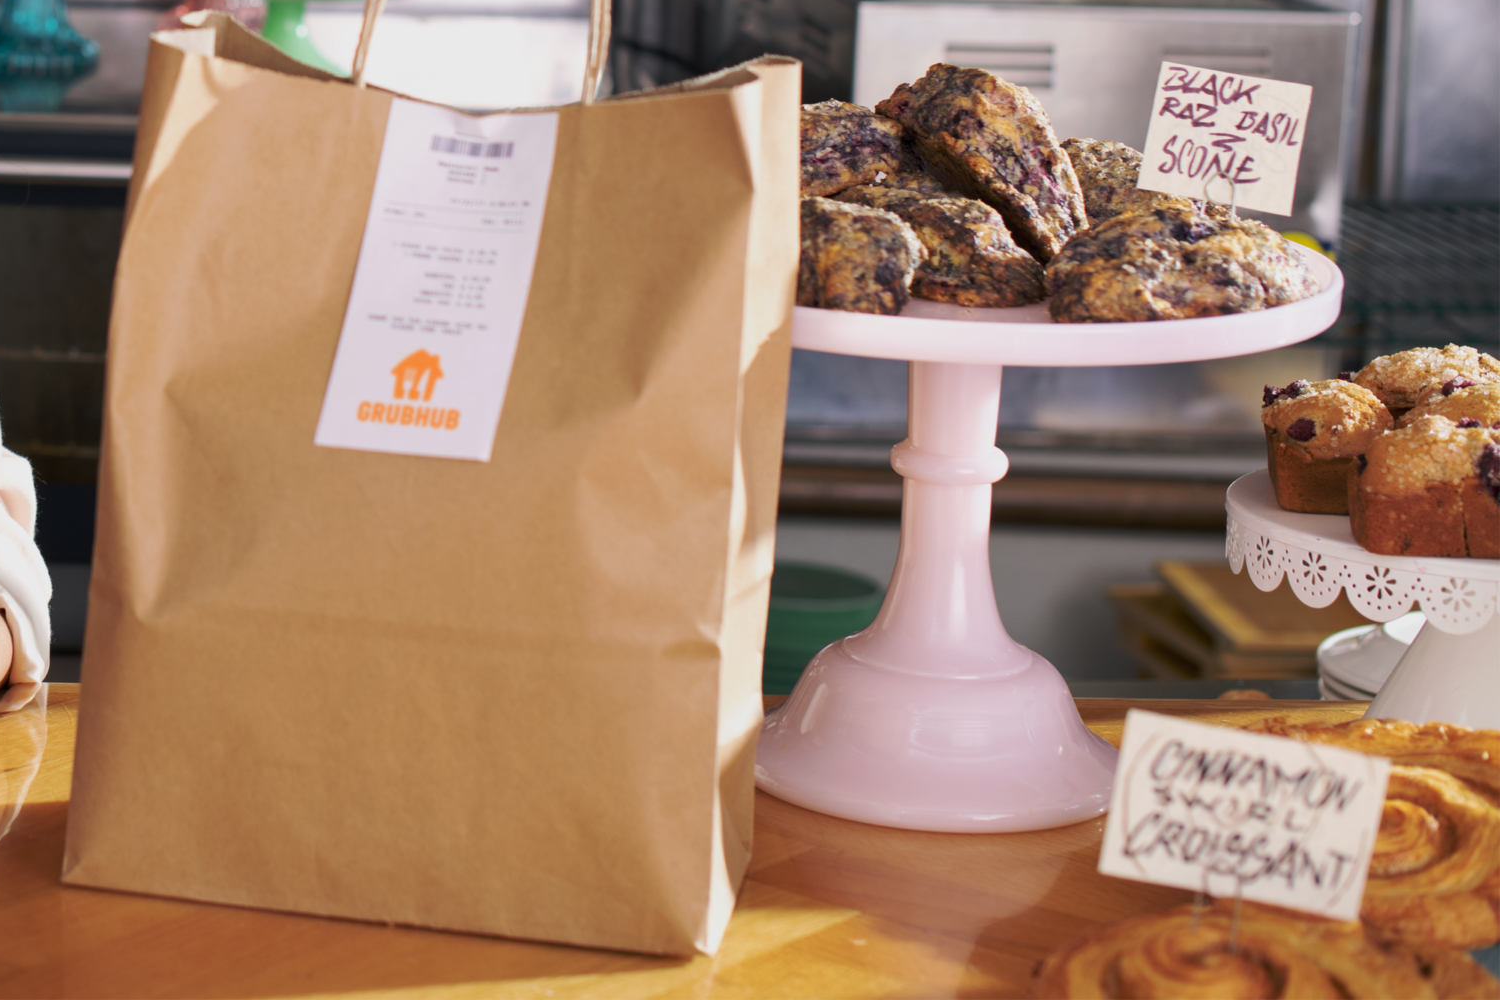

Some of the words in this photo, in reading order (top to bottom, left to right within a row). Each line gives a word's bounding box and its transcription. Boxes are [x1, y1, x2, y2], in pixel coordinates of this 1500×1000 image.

[1161, 66, 1262, 107] BLACK
[1158, 96, 1218, 128] RAZ
[1234, 110, 1300, 147] BASIL
[1157, 134, 1261, 185] SCONE
[356, 401, 461, 430] GRUBHUB
[1150, 738, 1363, 813] CINNAMON
[1122, 811, 1352, 892] CROISSANT
